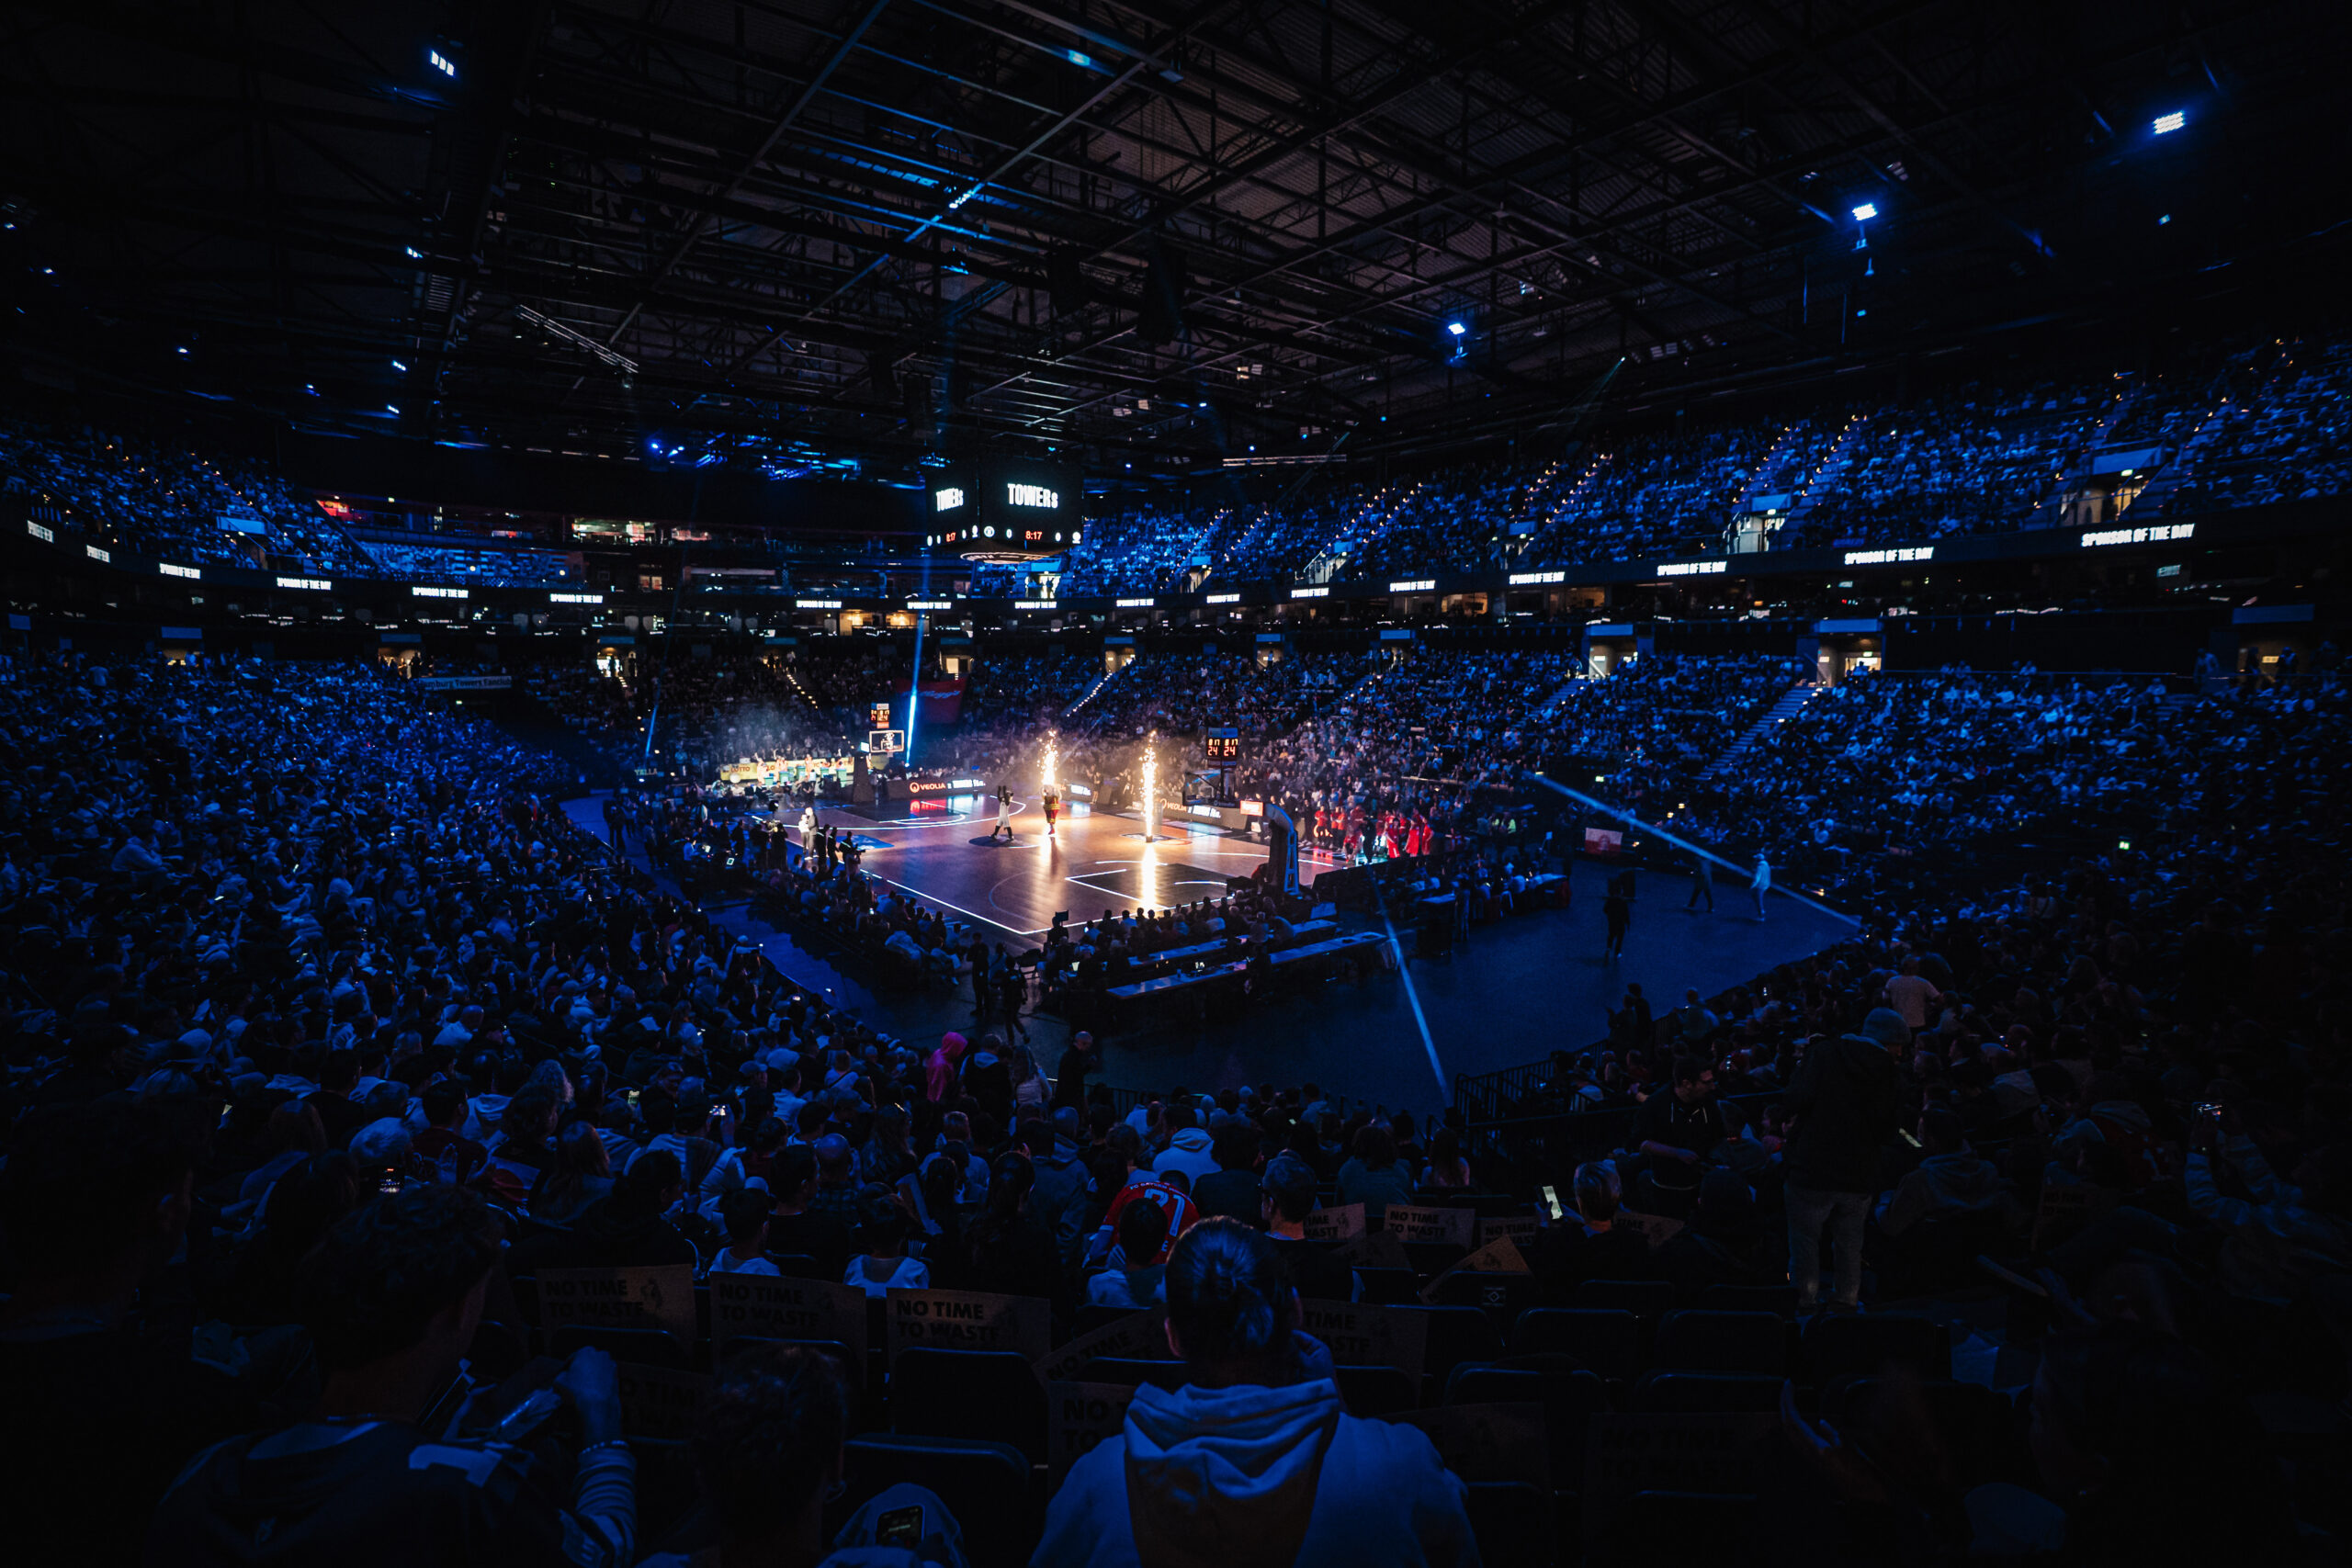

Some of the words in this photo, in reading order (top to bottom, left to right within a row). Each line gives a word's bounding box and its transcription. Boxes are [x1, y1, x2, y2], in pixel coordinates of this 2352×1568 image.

[1025, 530, 1043, 540] 8:17
[2132, 528, 2146, 542] OF
[2148, 526, 2169, 540] THE
[2170, 524, 2193, 538] DAY
[1224, 746, 1236, 757] 24
[1306, 1215, 1329, 1226] IME
[1390, 1211, 1408, 1222] NO
[1411, 1213, 1440, 1224] TIME
[1389, 1224, 1405, 1233] TO
[545, 1280, 576, 1296] NO
[579, 1280, 628, 1296] TIME
[718, 1283, 750, 1300] NO
[753, 1286, 804, 1304] TIME
[548, 1302, 573, 1317] TO
[577, 1302, 644, 1316] WASTE
[719, 1305, 745, 1321] TO
[751, 1306, 820, 1326] WASTE
[897, 1300, 928, 1315] NO
[933, 1301, 984, 1320] TIME
[1305, 1311, 1357, 1331] TIME
[897, 1322, 924, 1337] TO
[929, 1323, 1001, 1341] WASTE
[1047, 1356, 1079, 1381] NO
[1080, 1331, 1132, 1359] TIME
[645, 1381, 695, 1406] TIM
[1064, 1399, 1109, 1421] NO
[1062, 1428, 1101, 1451] TO
